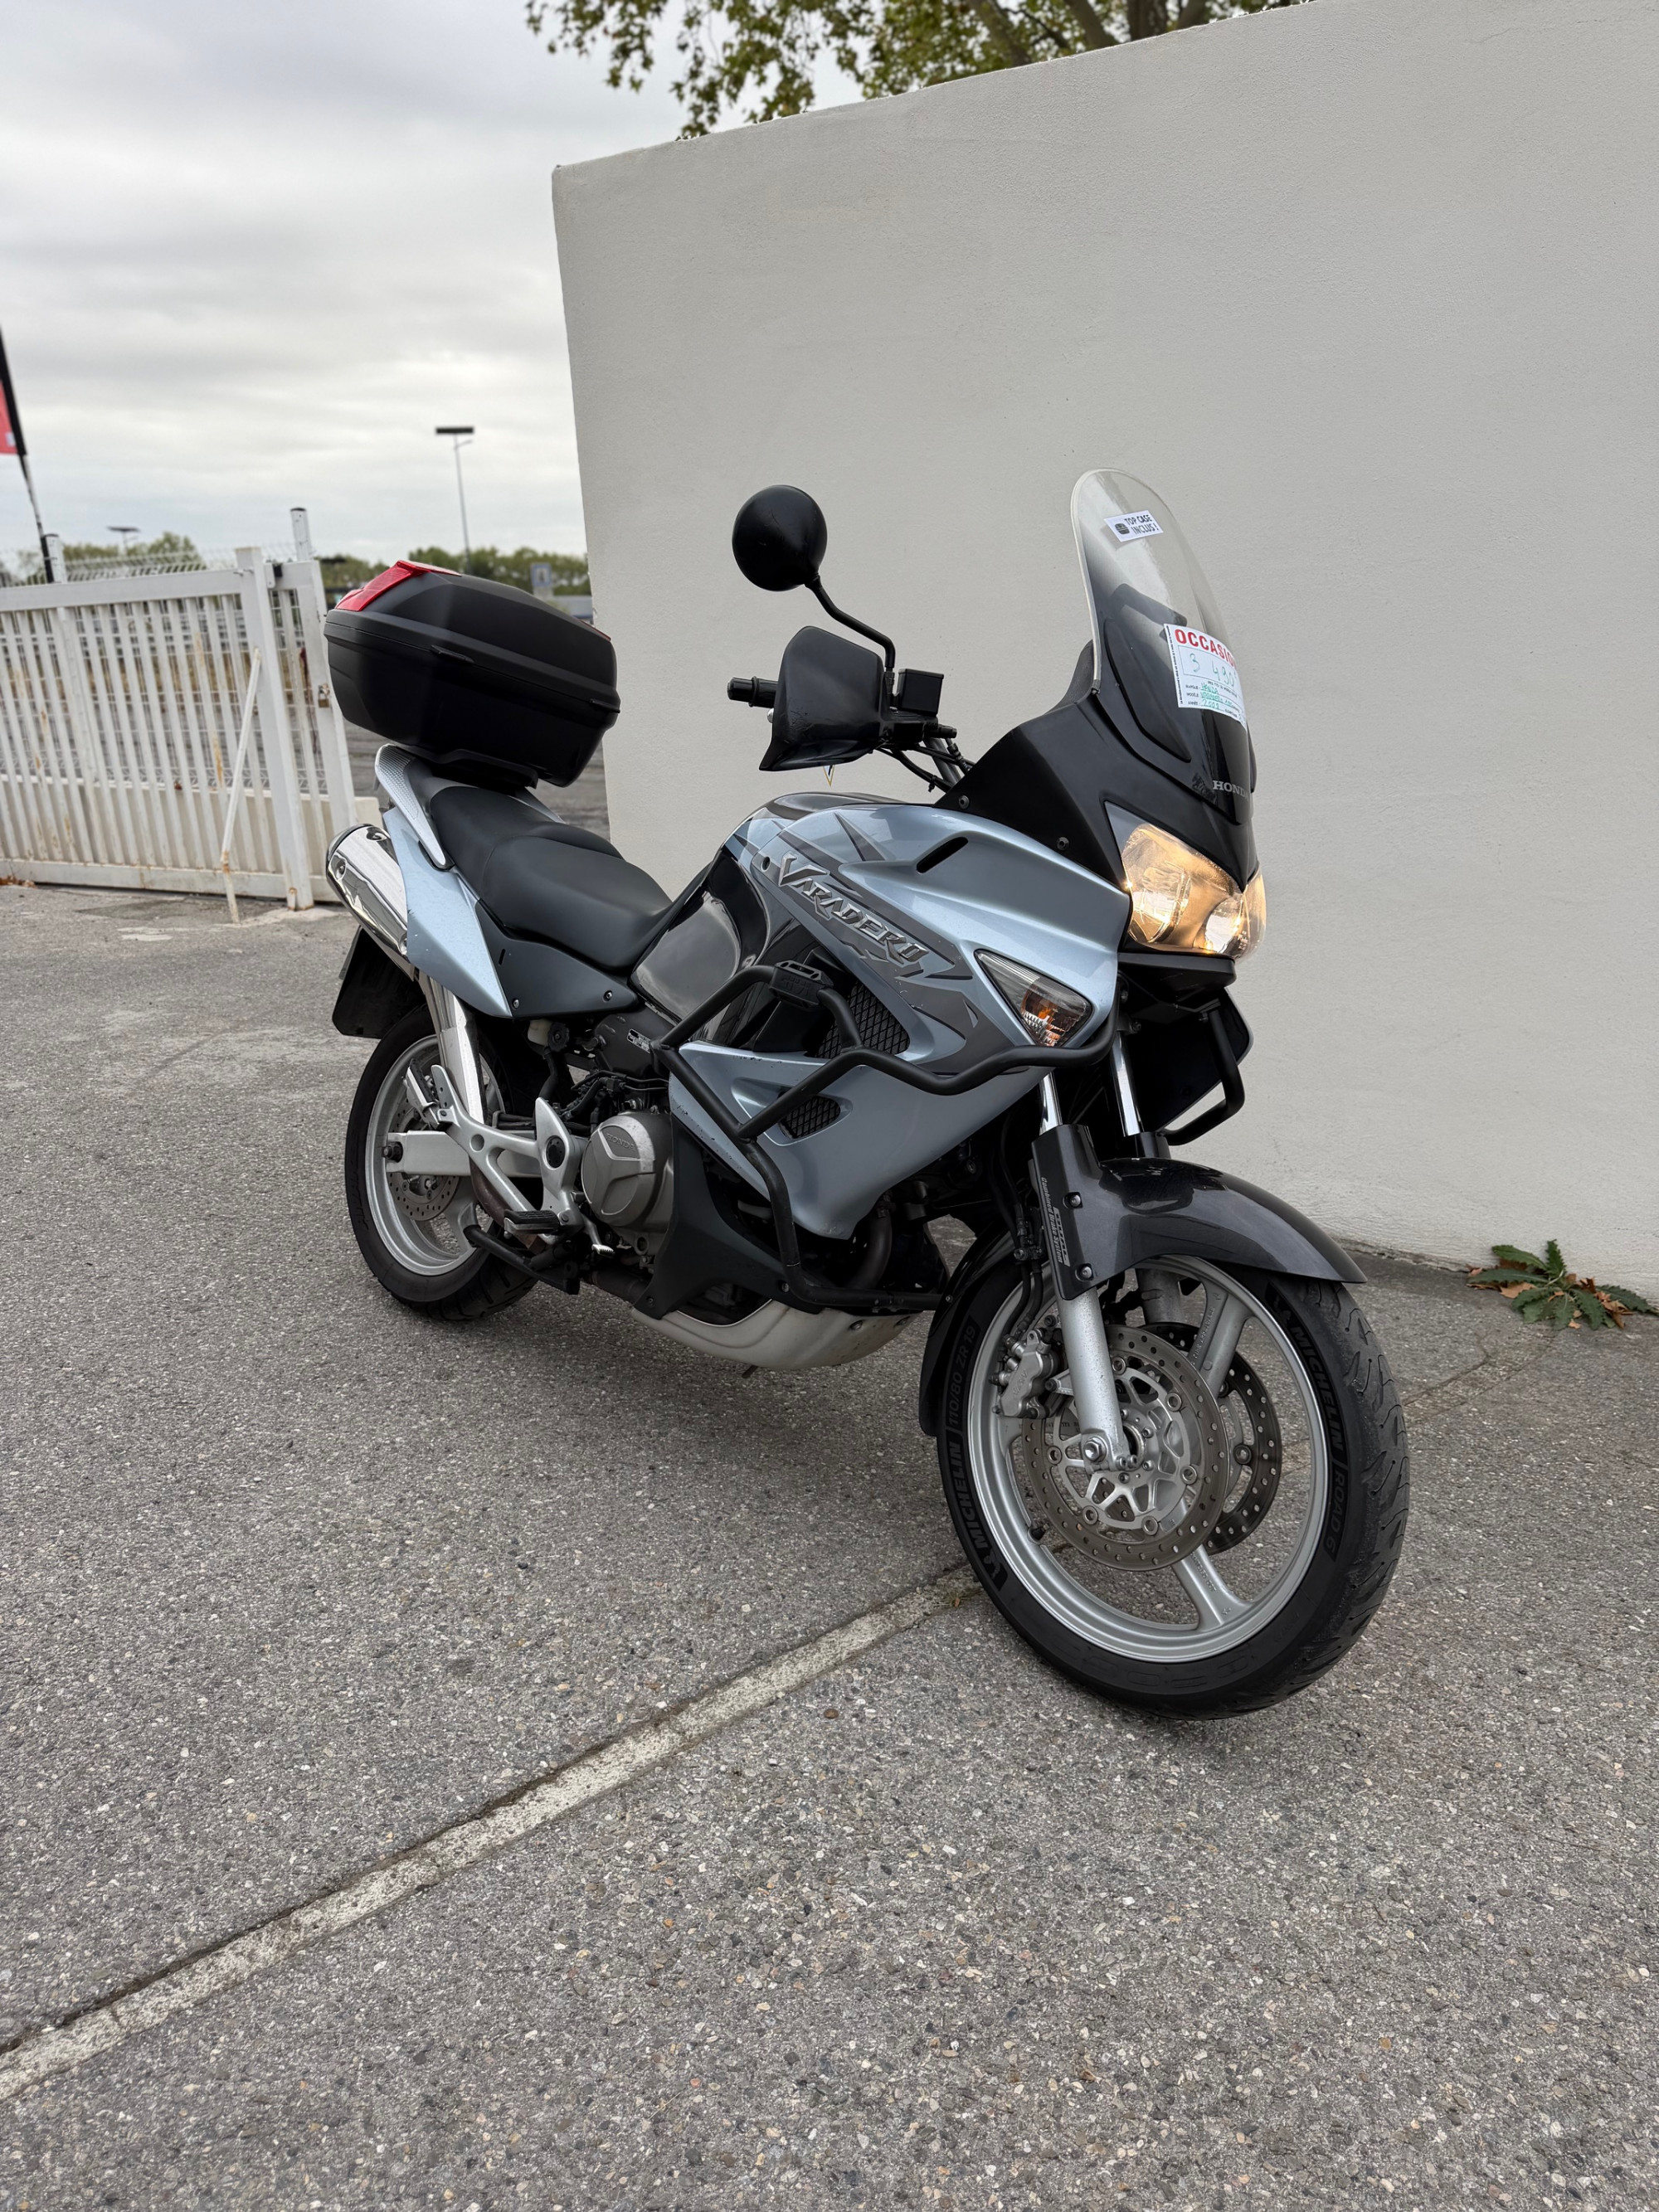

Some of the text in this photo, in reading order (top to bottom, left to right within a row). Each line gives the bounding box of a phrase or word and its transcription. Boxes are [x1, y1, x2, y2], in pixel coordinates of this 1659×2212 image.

[1124, 514, 1153, 526] TOP CASE
[1190, 653, 1199, 673] 3
[779, 852, 929, 965] VARADERO
[948, 1324, 980, 1548] MICHELIN 110/80 ZR 19
[1291, 1326, 1345, 1553] MICHELIN ROAD 6
